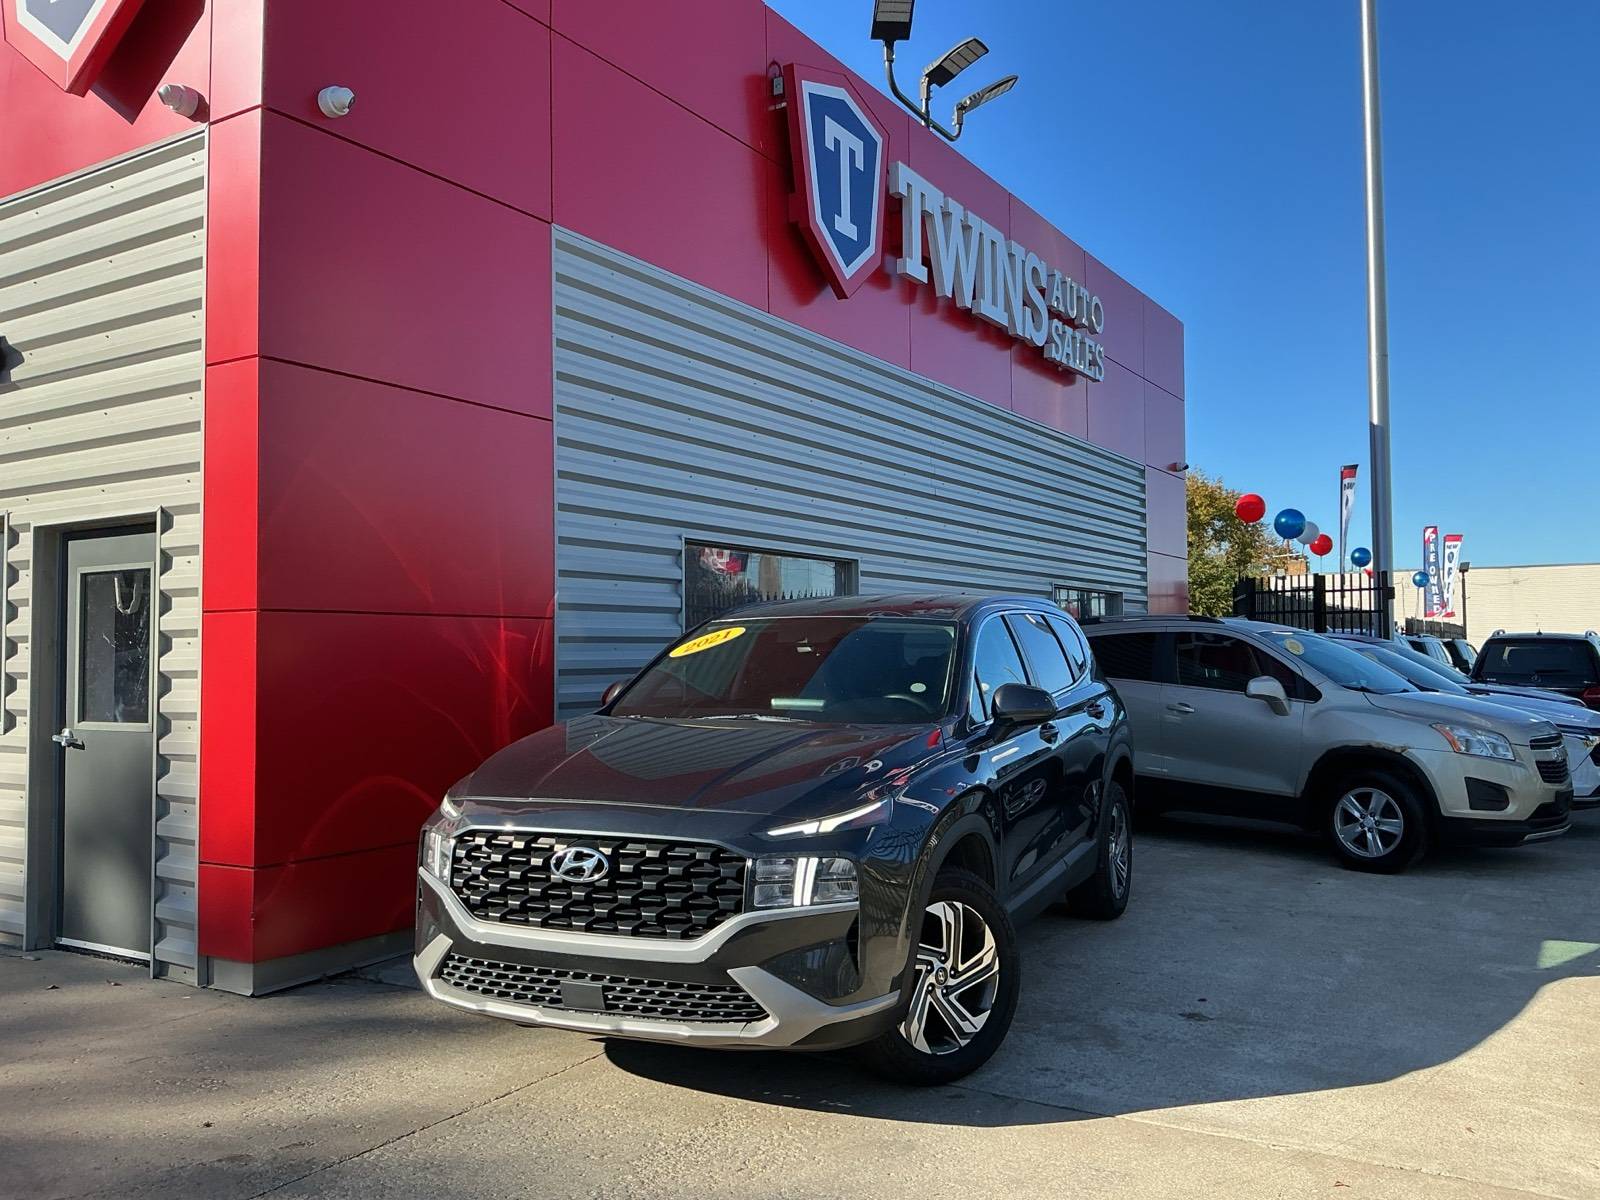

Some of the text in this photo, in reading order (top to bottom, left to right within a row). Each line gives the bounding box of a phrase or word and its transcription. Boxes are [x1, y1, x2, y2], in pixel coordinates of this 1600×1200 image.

[825, 115, 864, 242] T
[889, 161, 1049, 347] TWINS
[1050, 268, 1105, 335] AUTO
[1049, 318, 1105, 382] SALES
[1429, 533, 1437, 563] PRE
[683, 630, 732, 653] 2021
